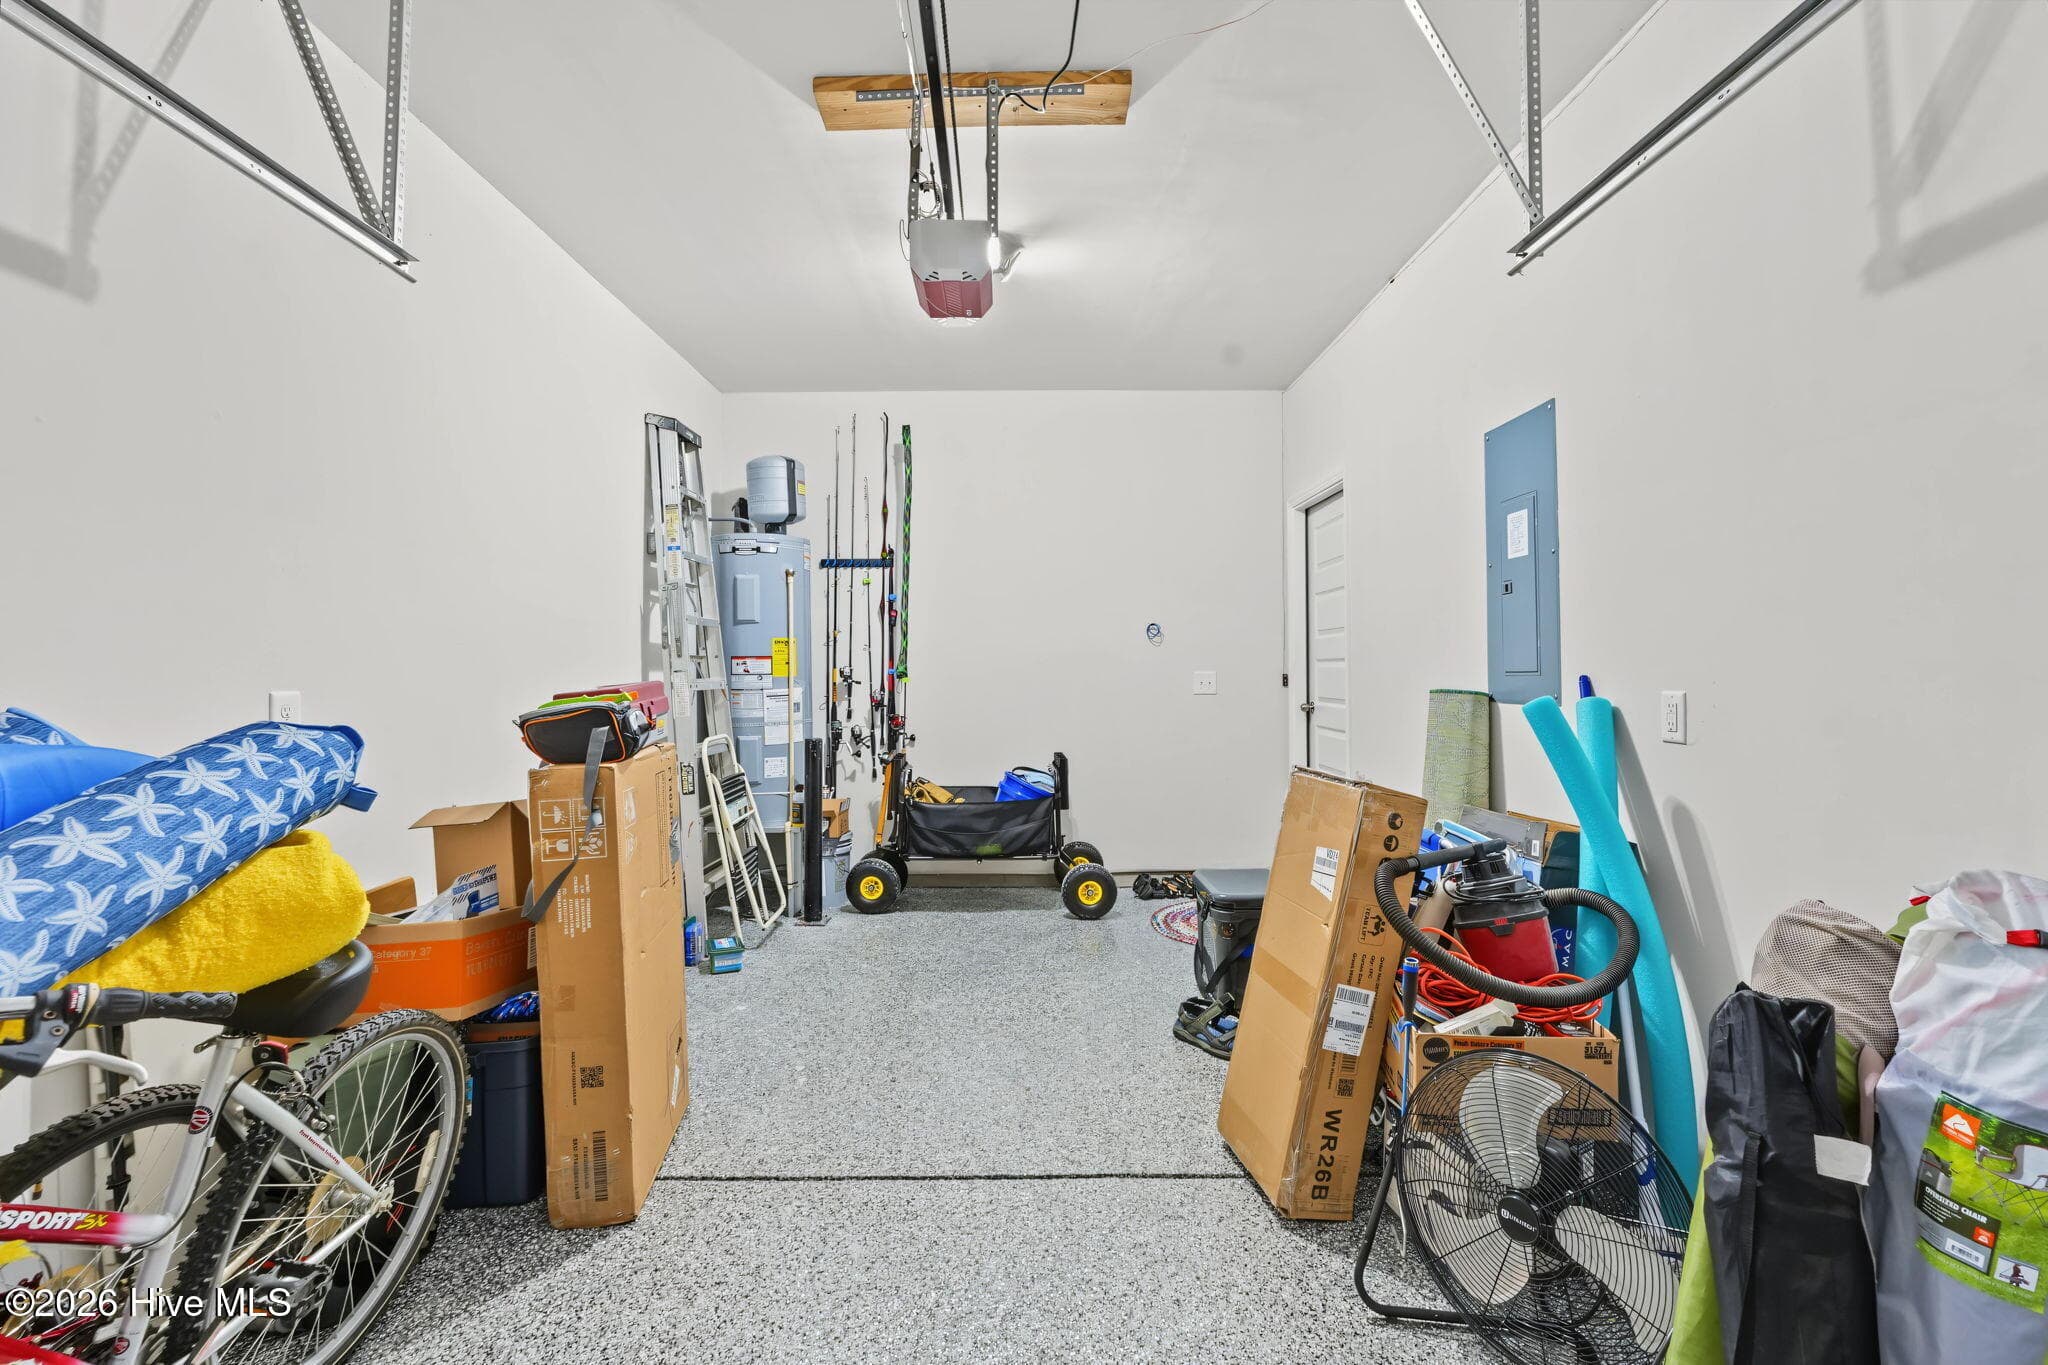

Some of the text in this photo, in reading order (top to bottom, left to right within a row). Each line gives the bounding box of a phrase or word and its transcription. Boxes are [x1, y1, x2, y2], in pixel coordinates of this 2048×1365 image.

[1360, 907, 1371, 941] TEAM LIFT
[1311, 1109, 1343, 1201] WR26B
[1960, 1206, 1988, 1225] CHAIR
